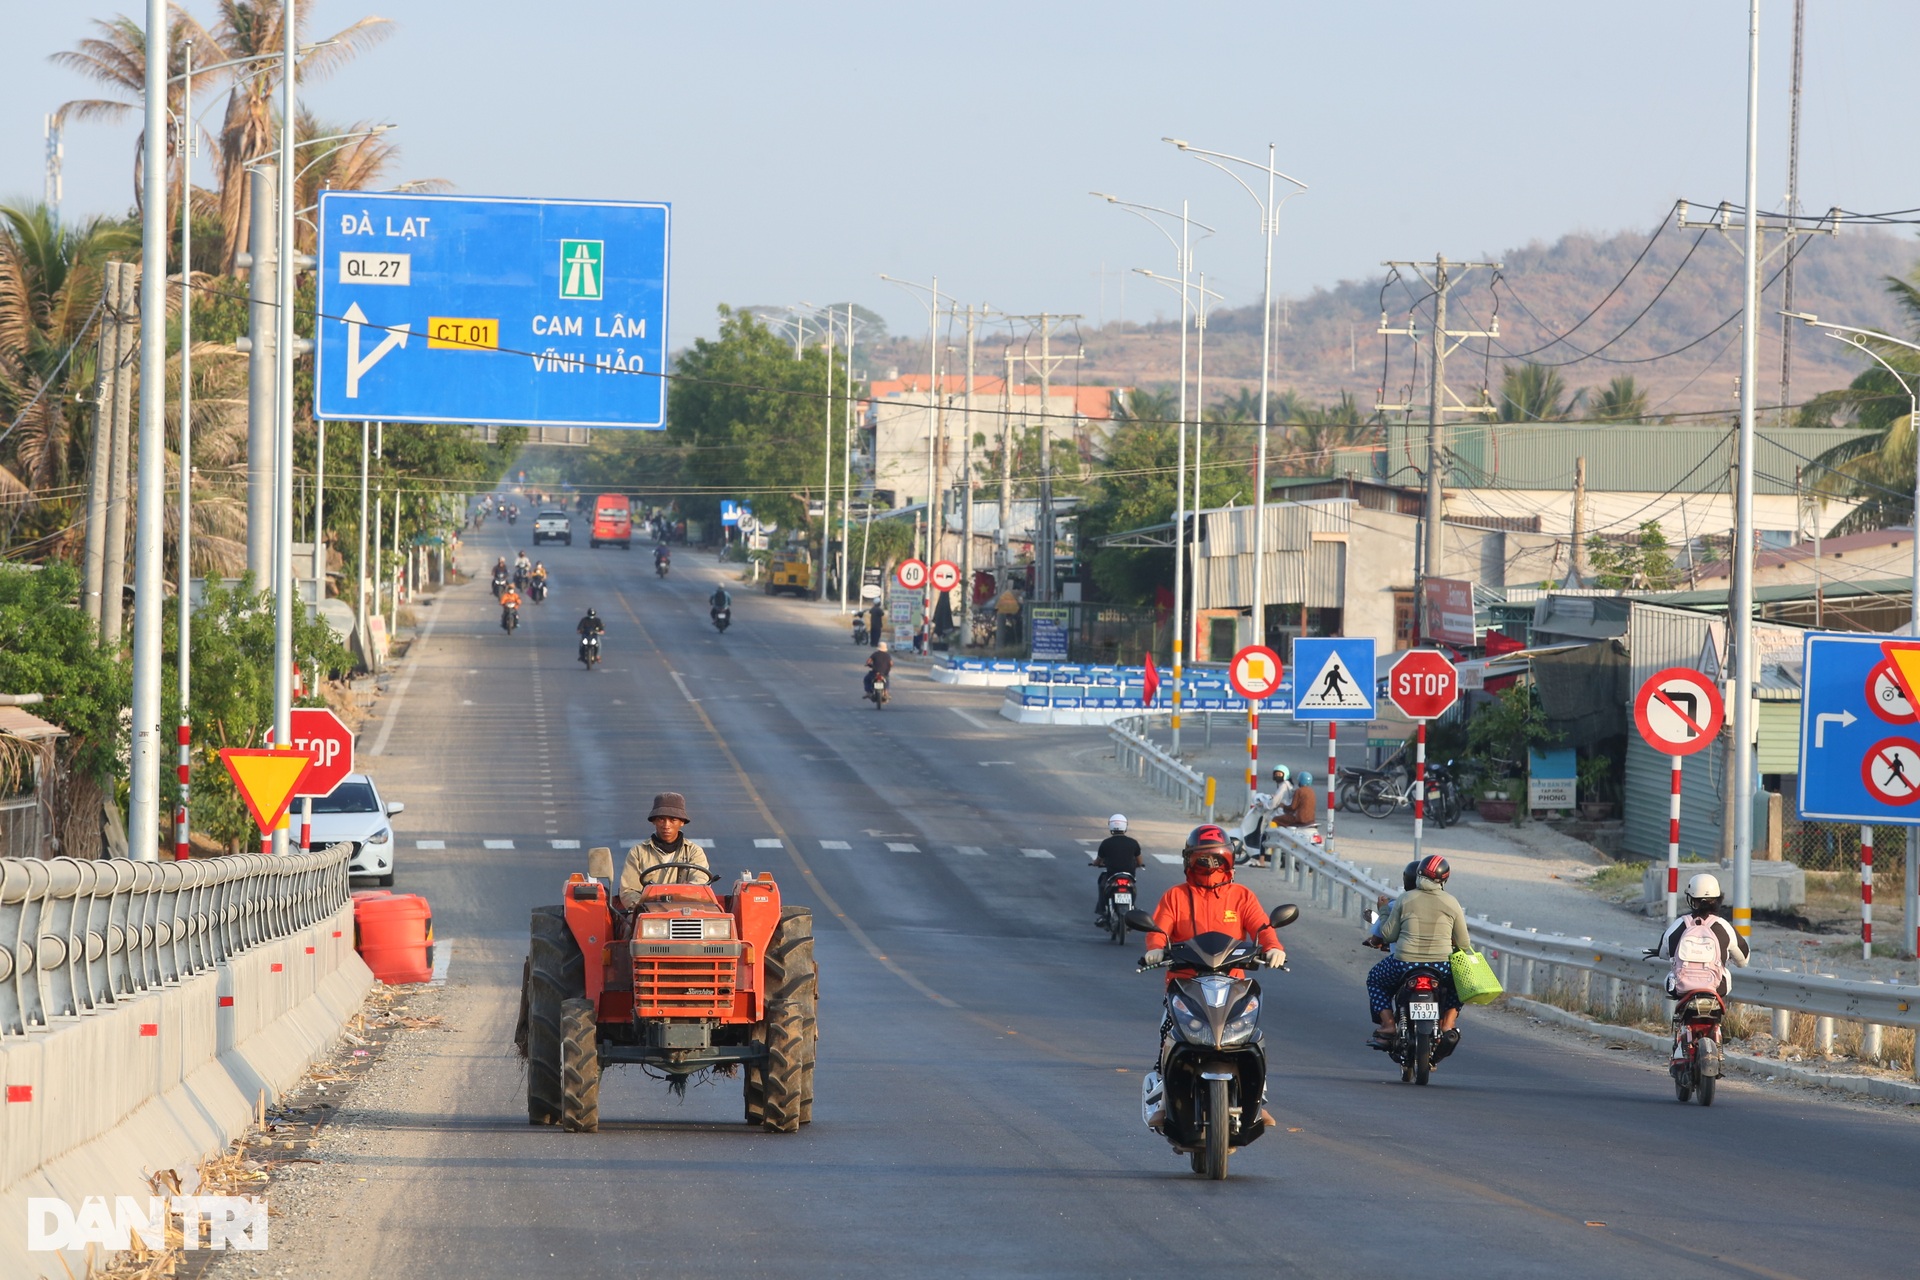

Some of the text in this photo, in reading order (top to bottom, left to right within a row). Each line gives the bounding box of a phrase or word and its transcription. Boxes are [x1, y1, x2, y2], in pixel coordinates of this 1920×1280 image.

[341, 210, 430, 241] ĐÀ LẠT
[347, 260, 400, 278] QL.27
[438, 324, 489, 343] CT.01
[532, 314, 645, 338] CAM LÂM
[532, 348, 643, 375] VĨNH HẢO
[906, 568, 919, 581] 60
[1398, 673, 1450, 696] STOP
[290, 739, 340, 766] TOP
